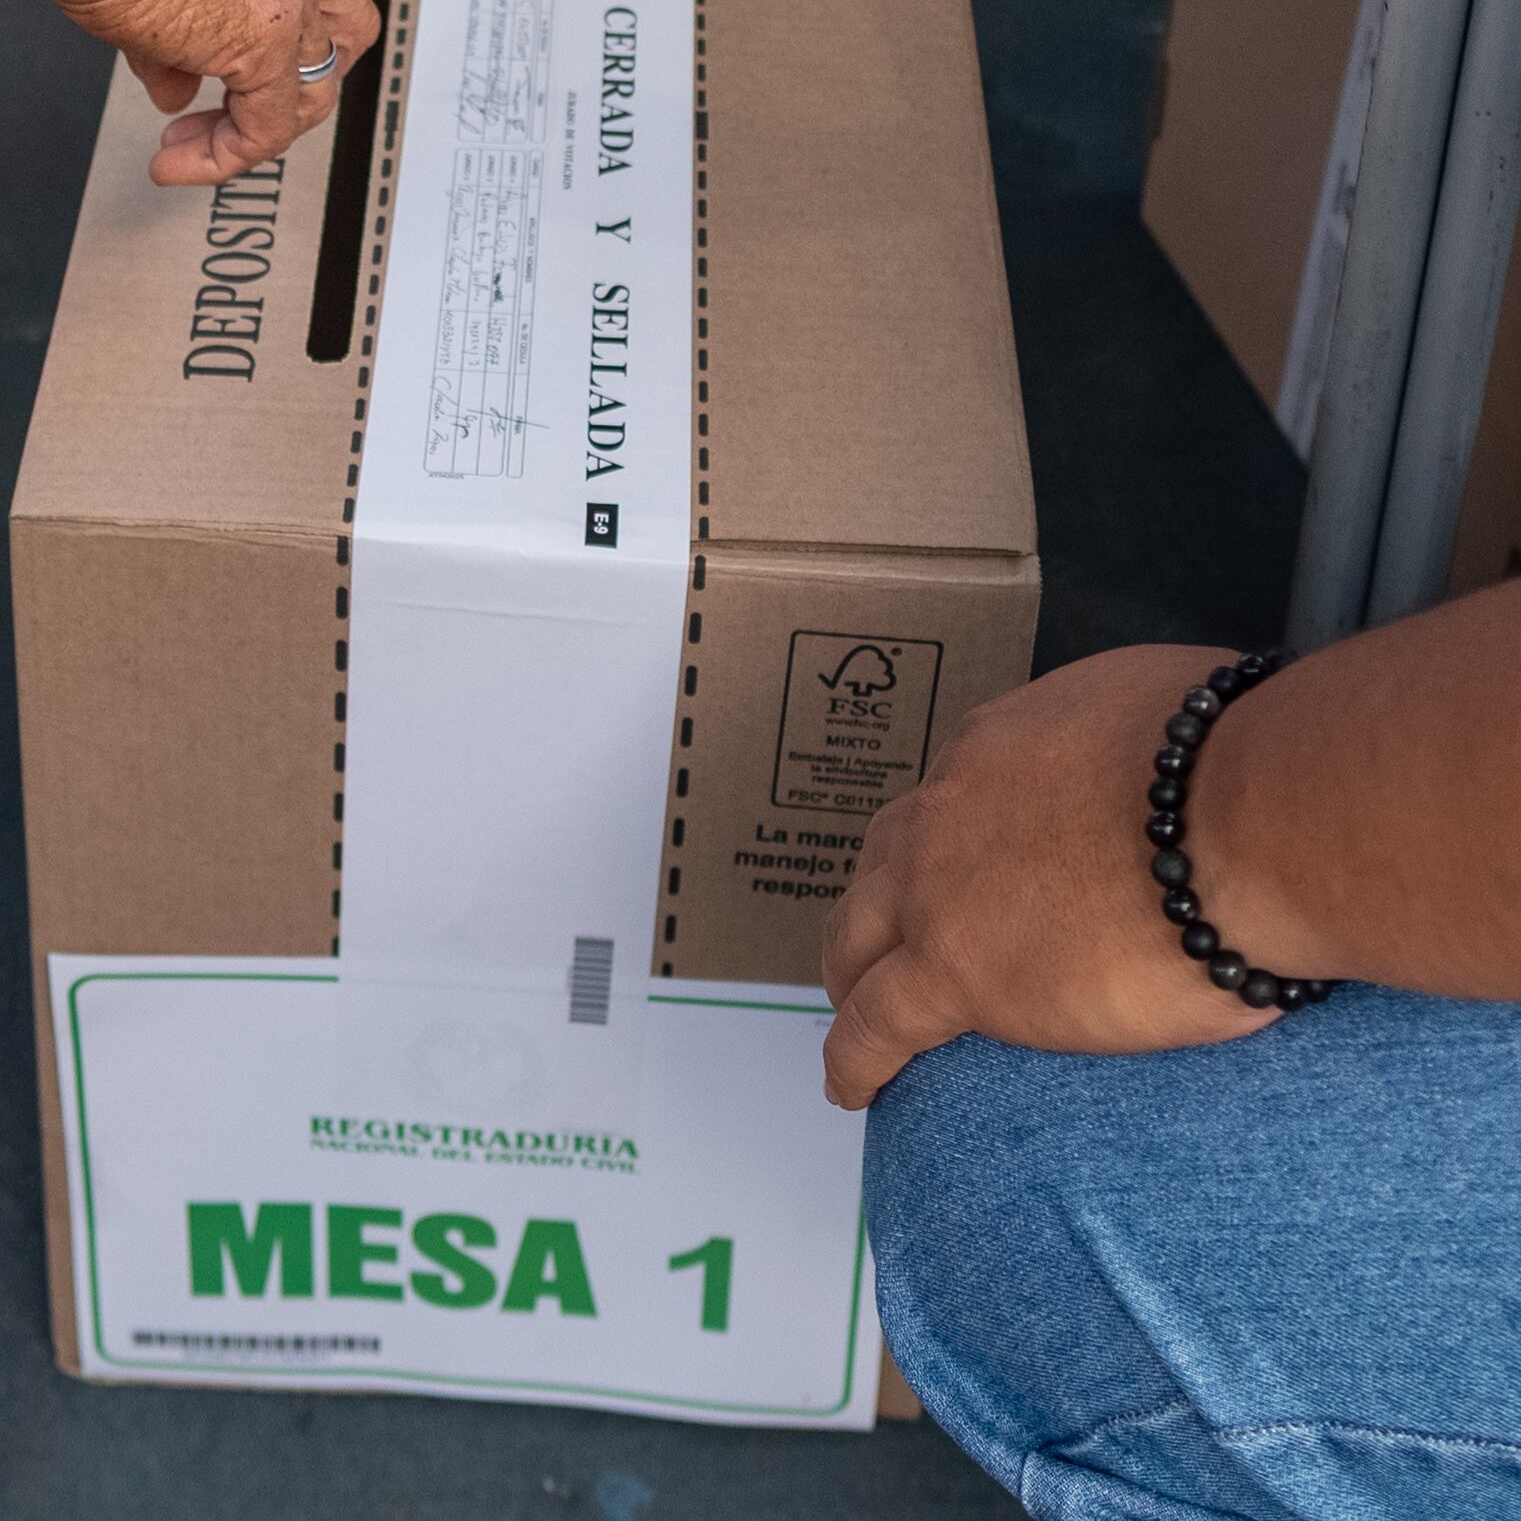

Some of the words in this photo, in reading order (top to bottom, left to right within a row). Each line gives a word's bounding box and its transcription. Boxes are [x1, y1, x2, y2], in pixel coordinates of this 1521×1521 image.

[598, 6, 639, 177] CERRADA
[566, 91, 578, 126] JURADO
[565, 128, 576, 140] DE
[563, 144, 575, 191] VOTACION
[594, 217, 631, 245] Y
[586, 282, 631, 482] SELLADA
[593, 513, 610, 535] E-9
[827, 697, 893, 719] FSC
[825, 734, 882, 751] MIXTO
[854, 756, 914, 772] Apoyando
[755, 823, 788, 843] La
[797, 832, 864, 851] marc
[733, 848, 835, 876] manejo
[752, 875, 847, 900] respon
[309, 1138, 420, 1157] NACIONAL
[431, 1146, 472, 1162] DEL
[484, 1150, 574, 1168] ESTADO
[580, 1157, 639, 1175] CIVIL
[186, 1200, 598, 1319] MESA
[667, 1235, 736, 1334] 1
